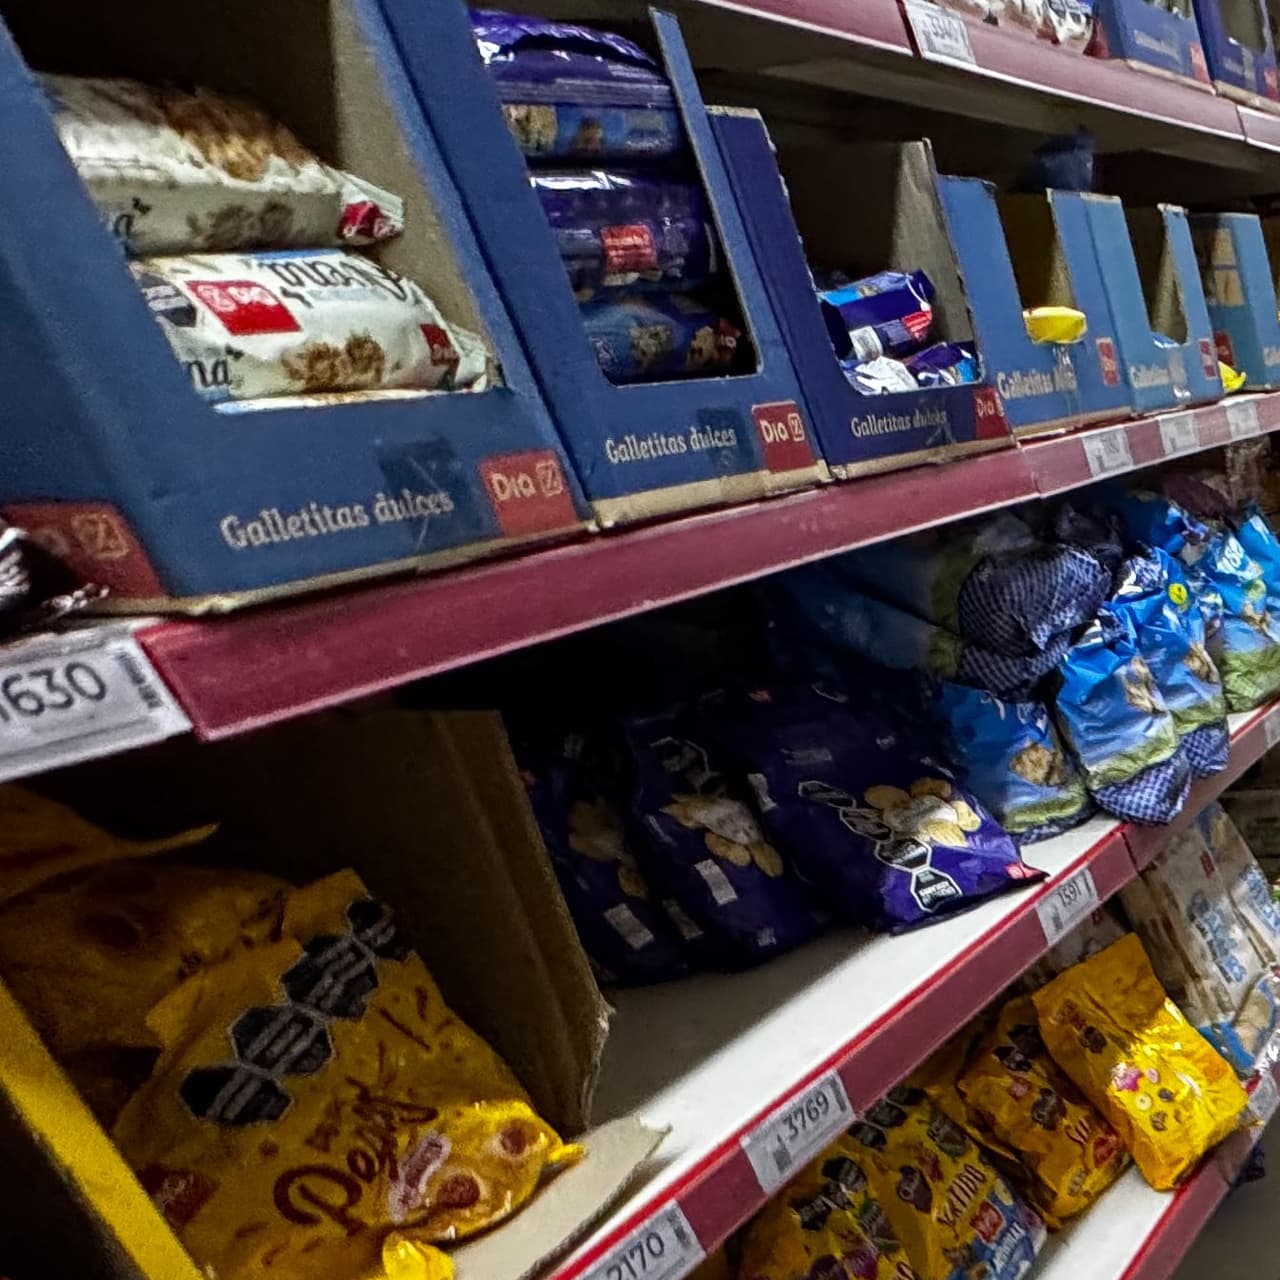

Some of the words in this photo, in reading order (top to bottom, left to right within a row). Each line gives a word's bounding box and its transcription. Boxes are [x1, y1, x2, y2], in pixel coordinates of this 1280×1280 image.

[606, 433, 687, 464] Galletitas
[690, 425, 738, 452] dulces
[851, 412, 912, 439] Galletitas
[220, 501, 370, 550] Galletitas
[374, 490, 456, 526] dulces
[0, 661, 108, 723] 630
[782, 1089, 830, 1141] 3769
